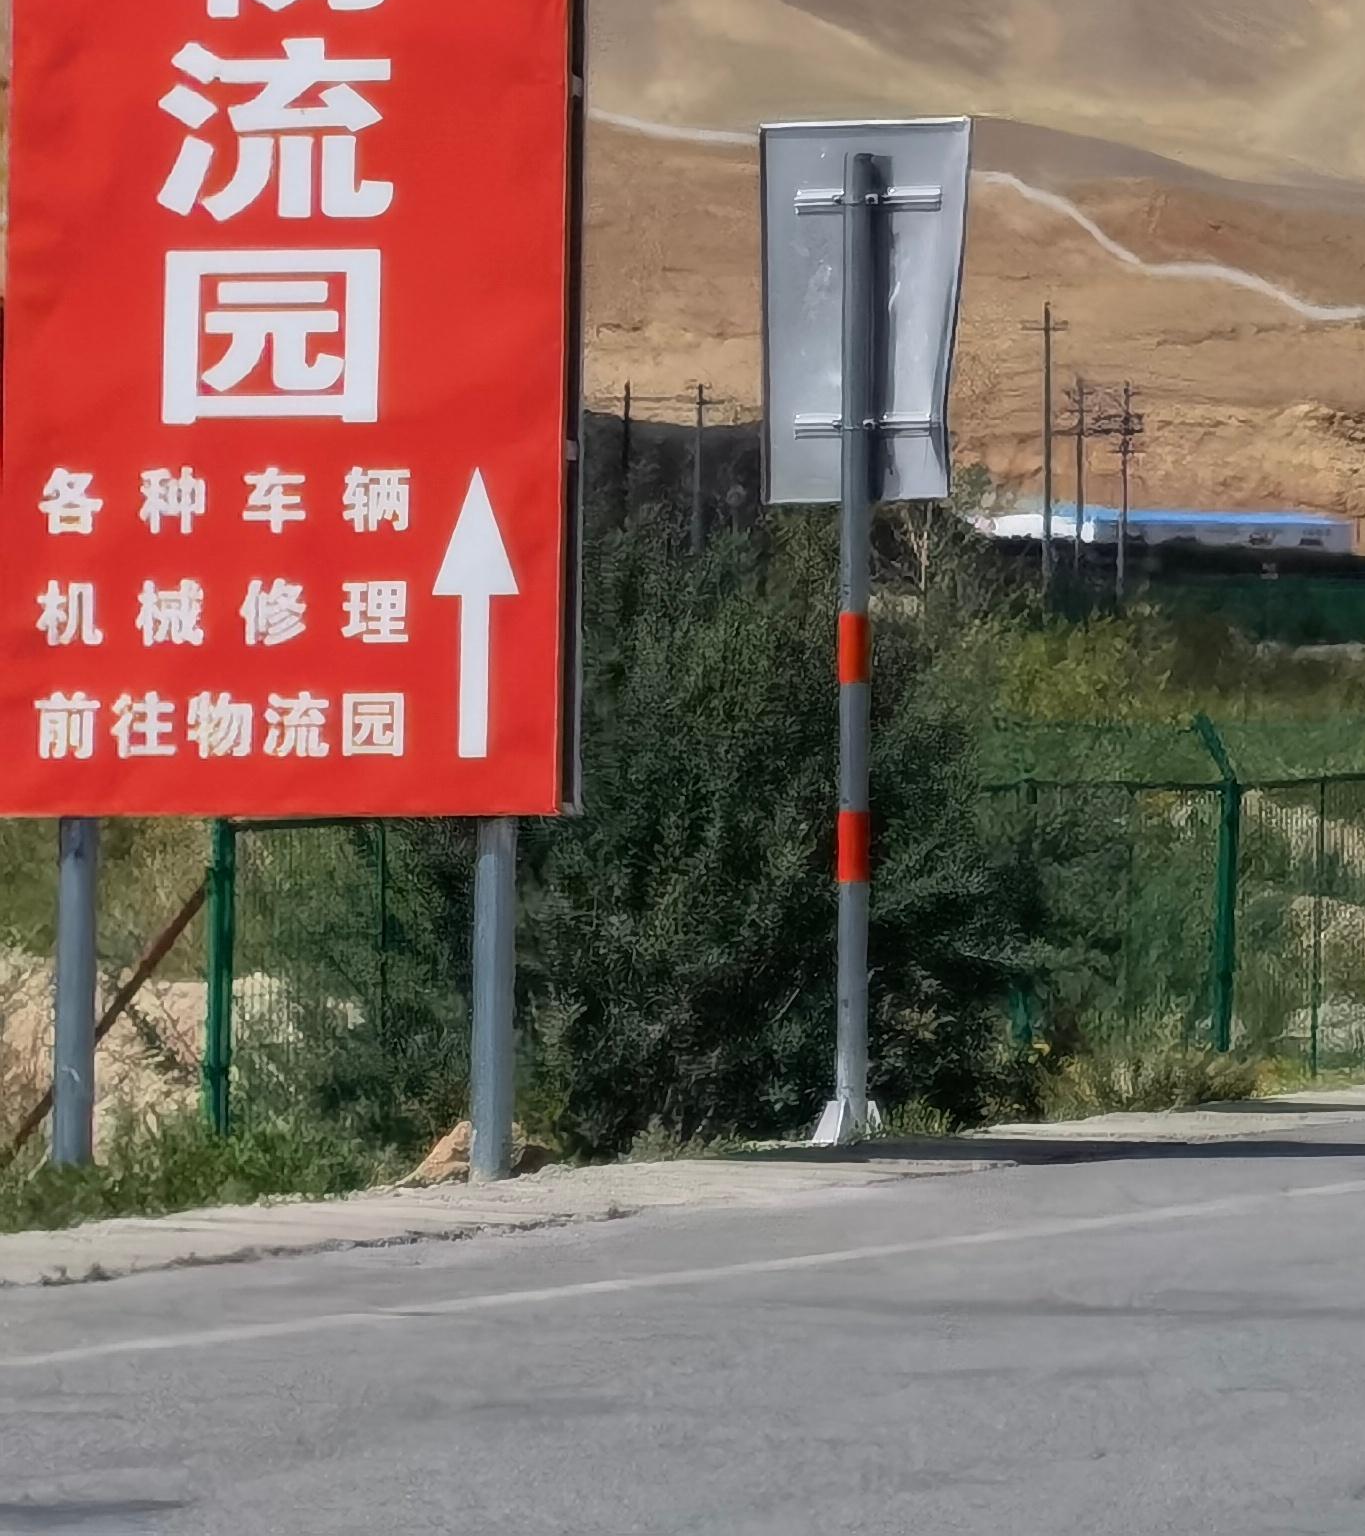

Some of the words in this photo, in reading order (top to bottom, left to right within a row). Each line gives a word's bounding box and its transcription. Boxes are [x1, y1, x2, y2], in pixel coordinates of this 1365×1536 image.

[38, 466, 410, 534] 各种车辆
[36, 578, 408, 647] 机械修理
[34, 691, 404, 759] 前往物流园
